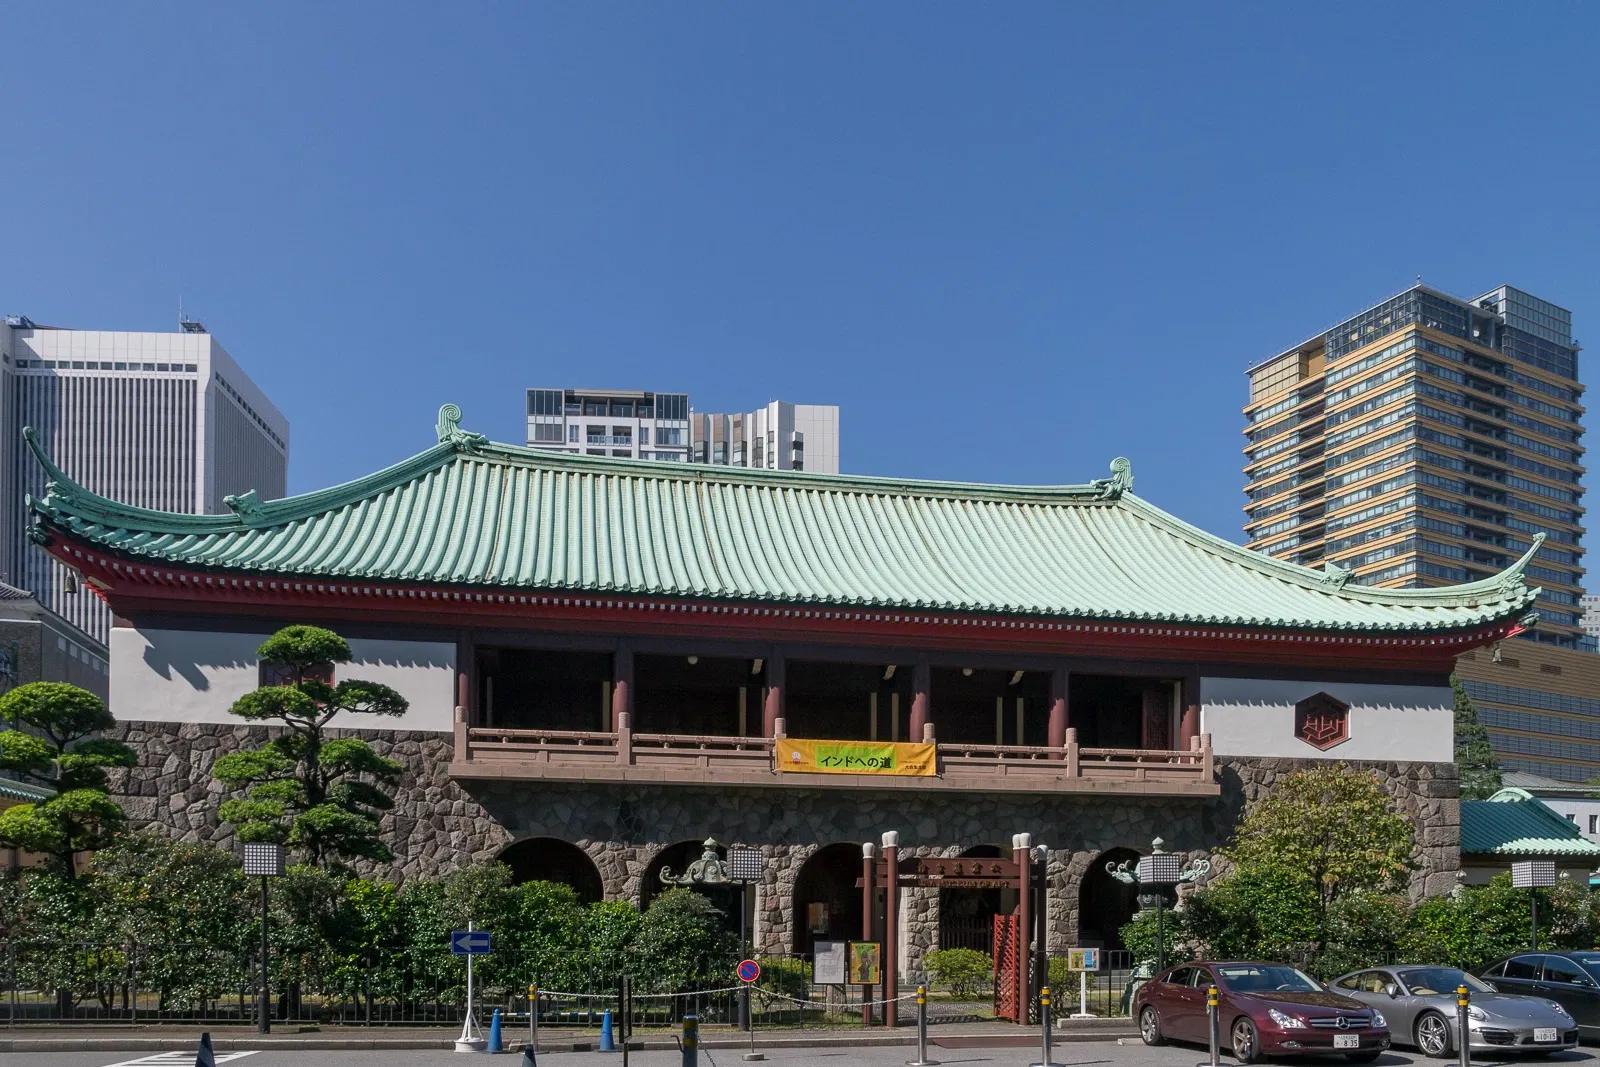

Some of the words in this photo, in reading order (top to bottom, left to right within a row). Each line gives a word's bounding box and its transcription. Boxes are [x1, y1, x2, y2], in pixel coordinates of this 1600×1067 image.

[820, 755, 892, 769] インドへの道
